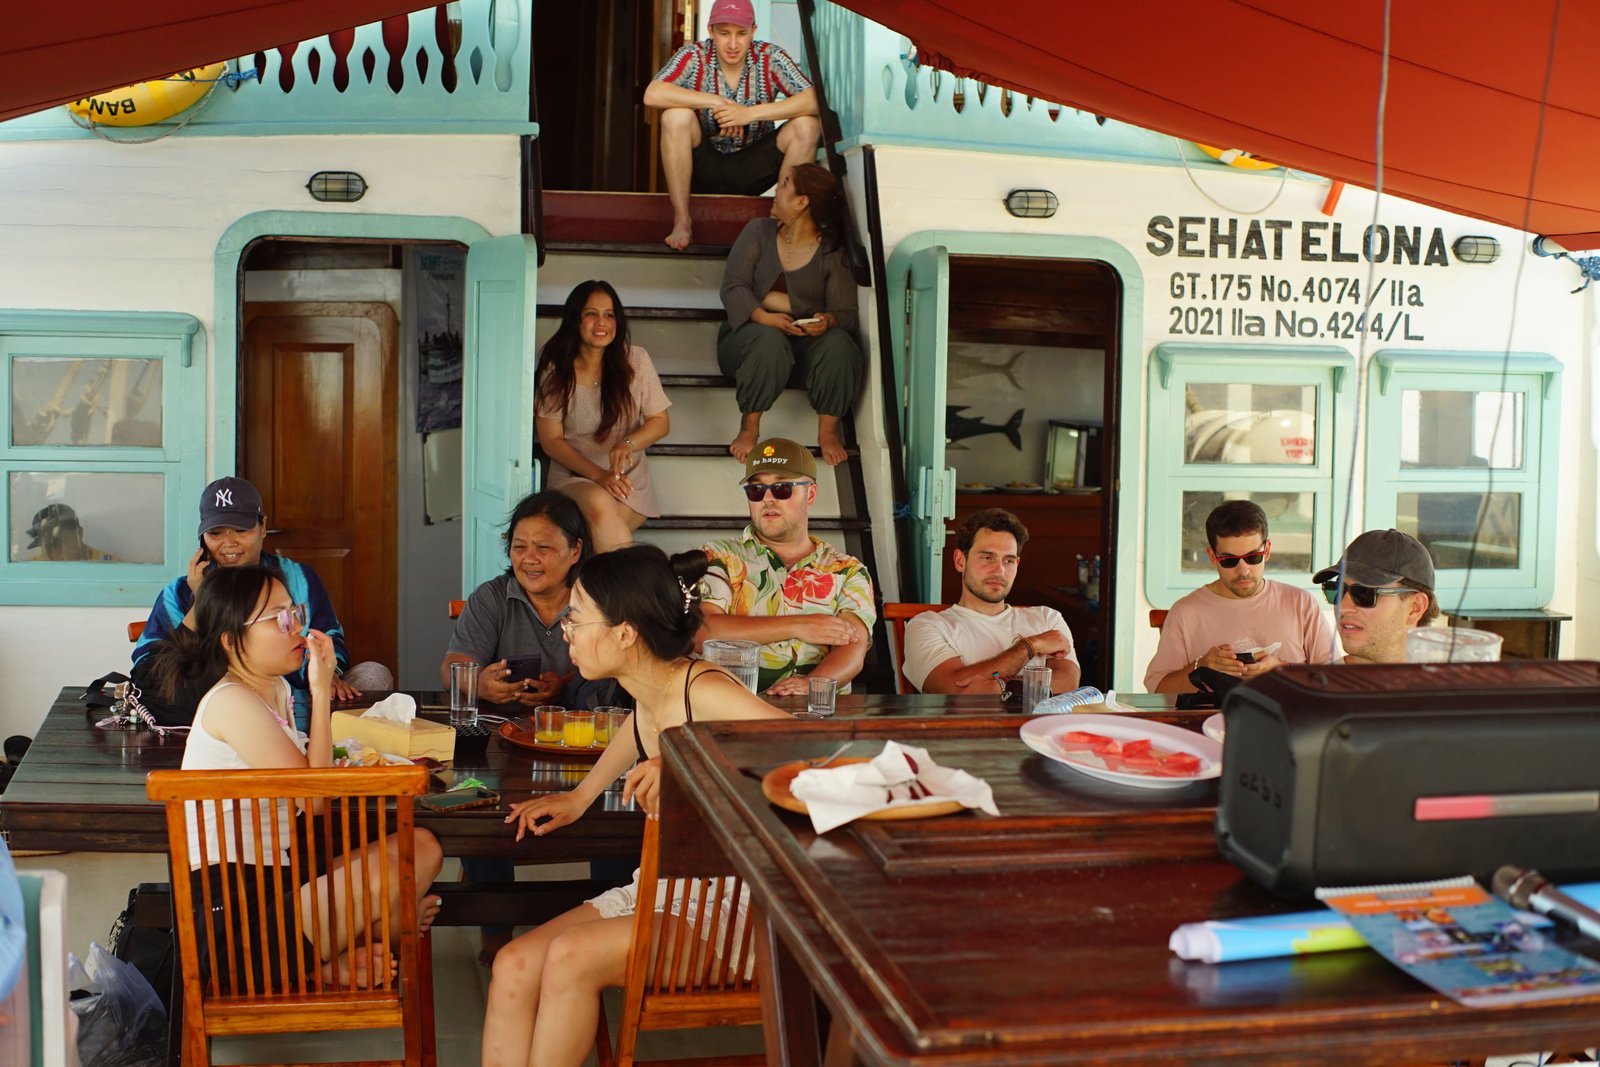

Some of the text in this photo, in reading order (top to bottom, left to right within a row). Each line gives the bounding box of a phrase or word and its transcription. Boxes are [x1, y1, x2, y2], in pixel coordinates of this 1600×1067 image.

[1146, 215, 1293, 261] SEHAT
[1169, 271, 1252, 301] GT.175
[1168, 305, 1223, 336] 2021
[215, 488, 233, 507] NY
